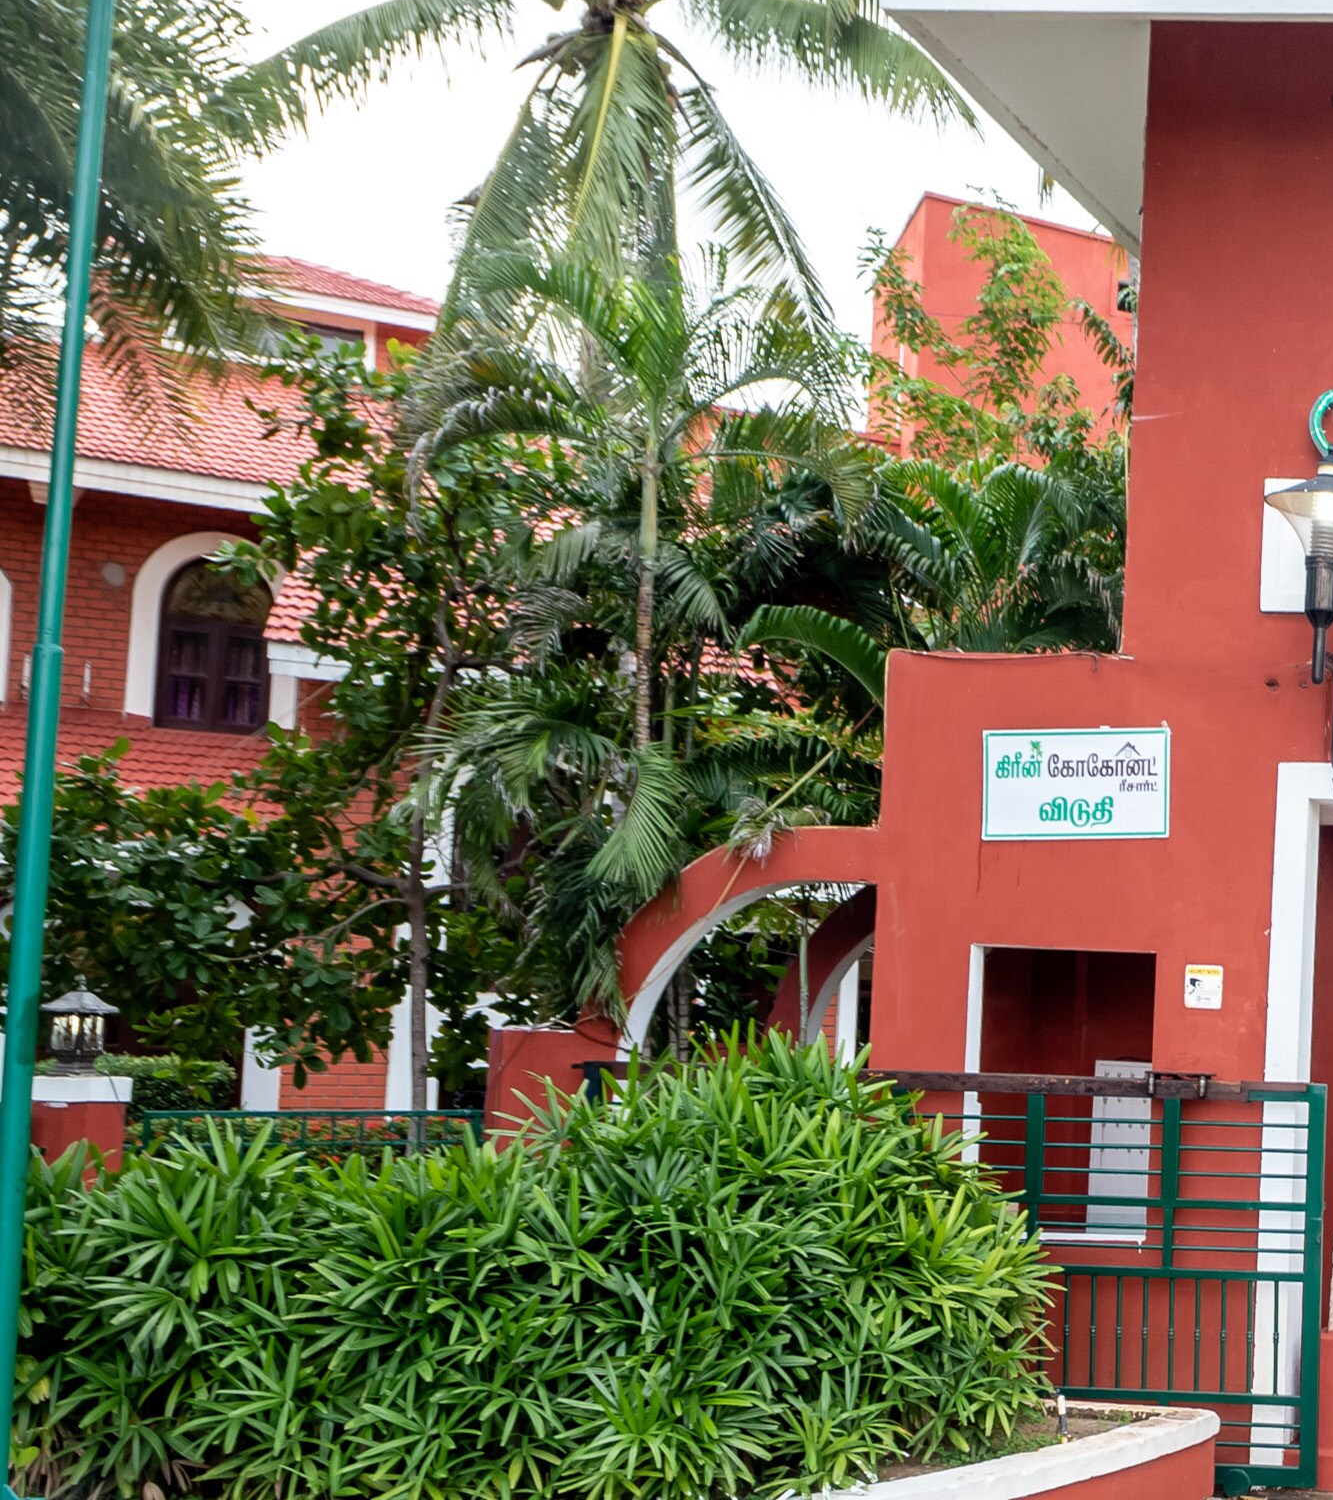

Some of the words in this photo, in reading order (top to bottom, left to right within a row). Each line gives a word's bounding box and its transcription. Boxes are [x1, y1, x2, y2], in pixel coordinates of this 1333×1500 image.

[995, 751, 1043, 779] கிரீன்
[1047, 753, 1158, 778] கோகோனட்
[1039, 796, 1114, 828] விடுதி
